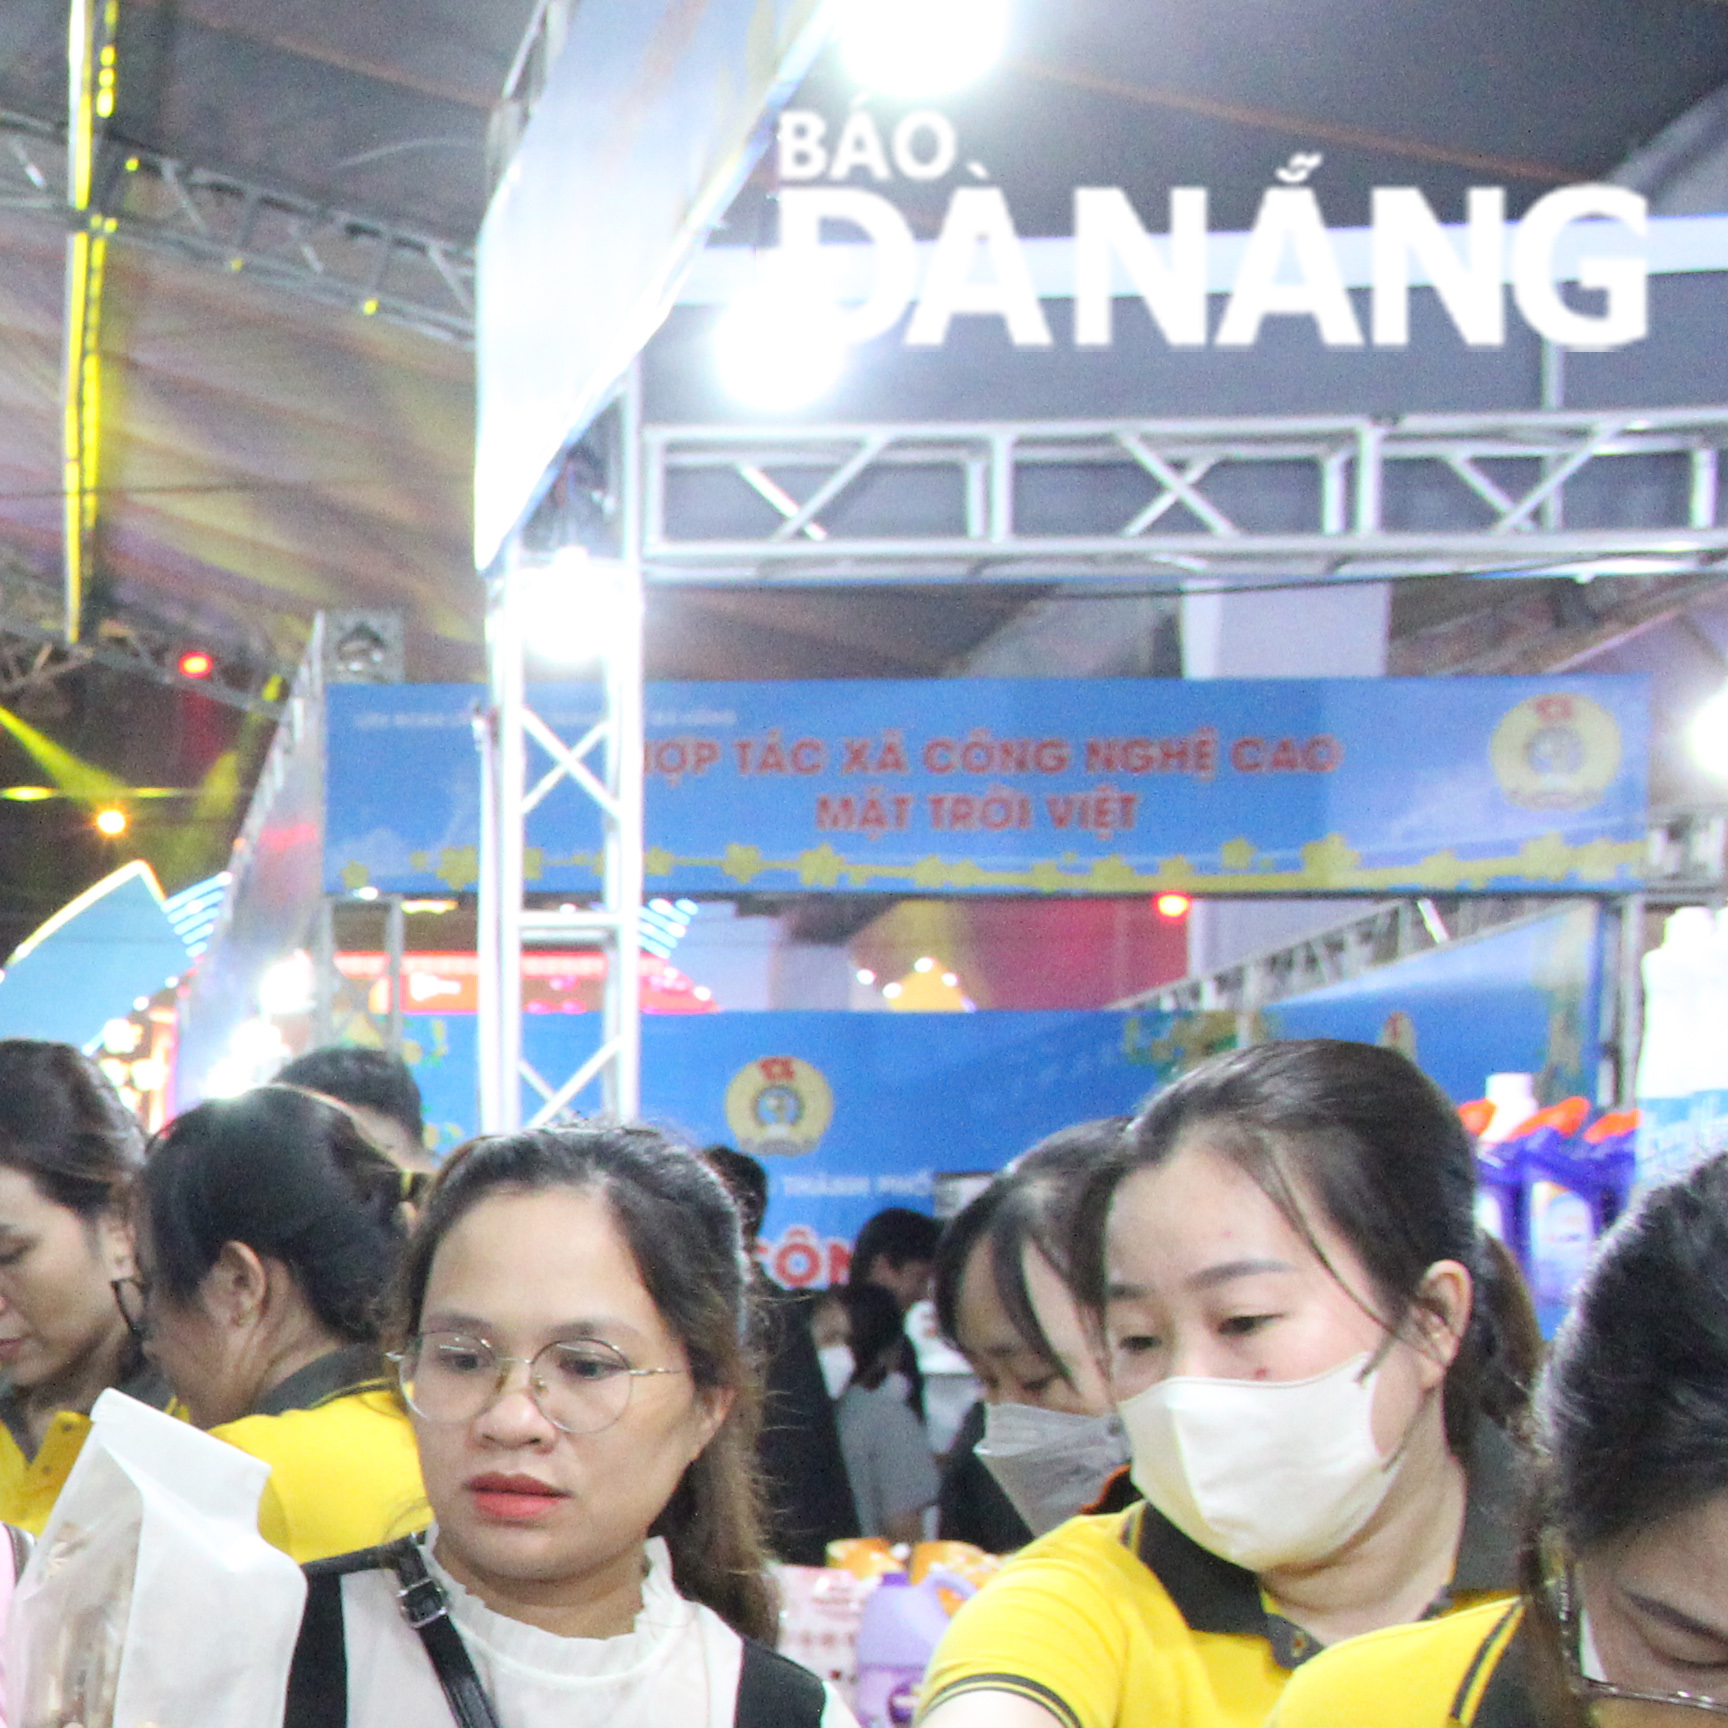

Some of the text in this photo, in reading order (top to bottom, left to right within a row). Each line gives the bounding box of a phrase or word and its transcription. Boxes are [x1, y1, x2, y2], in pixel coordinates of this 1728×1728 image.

[734, 727, 829, 776] TÁC
[921, 726, 1070, 775] CÔNG
[1230, 734, 1344, 774] CAO
